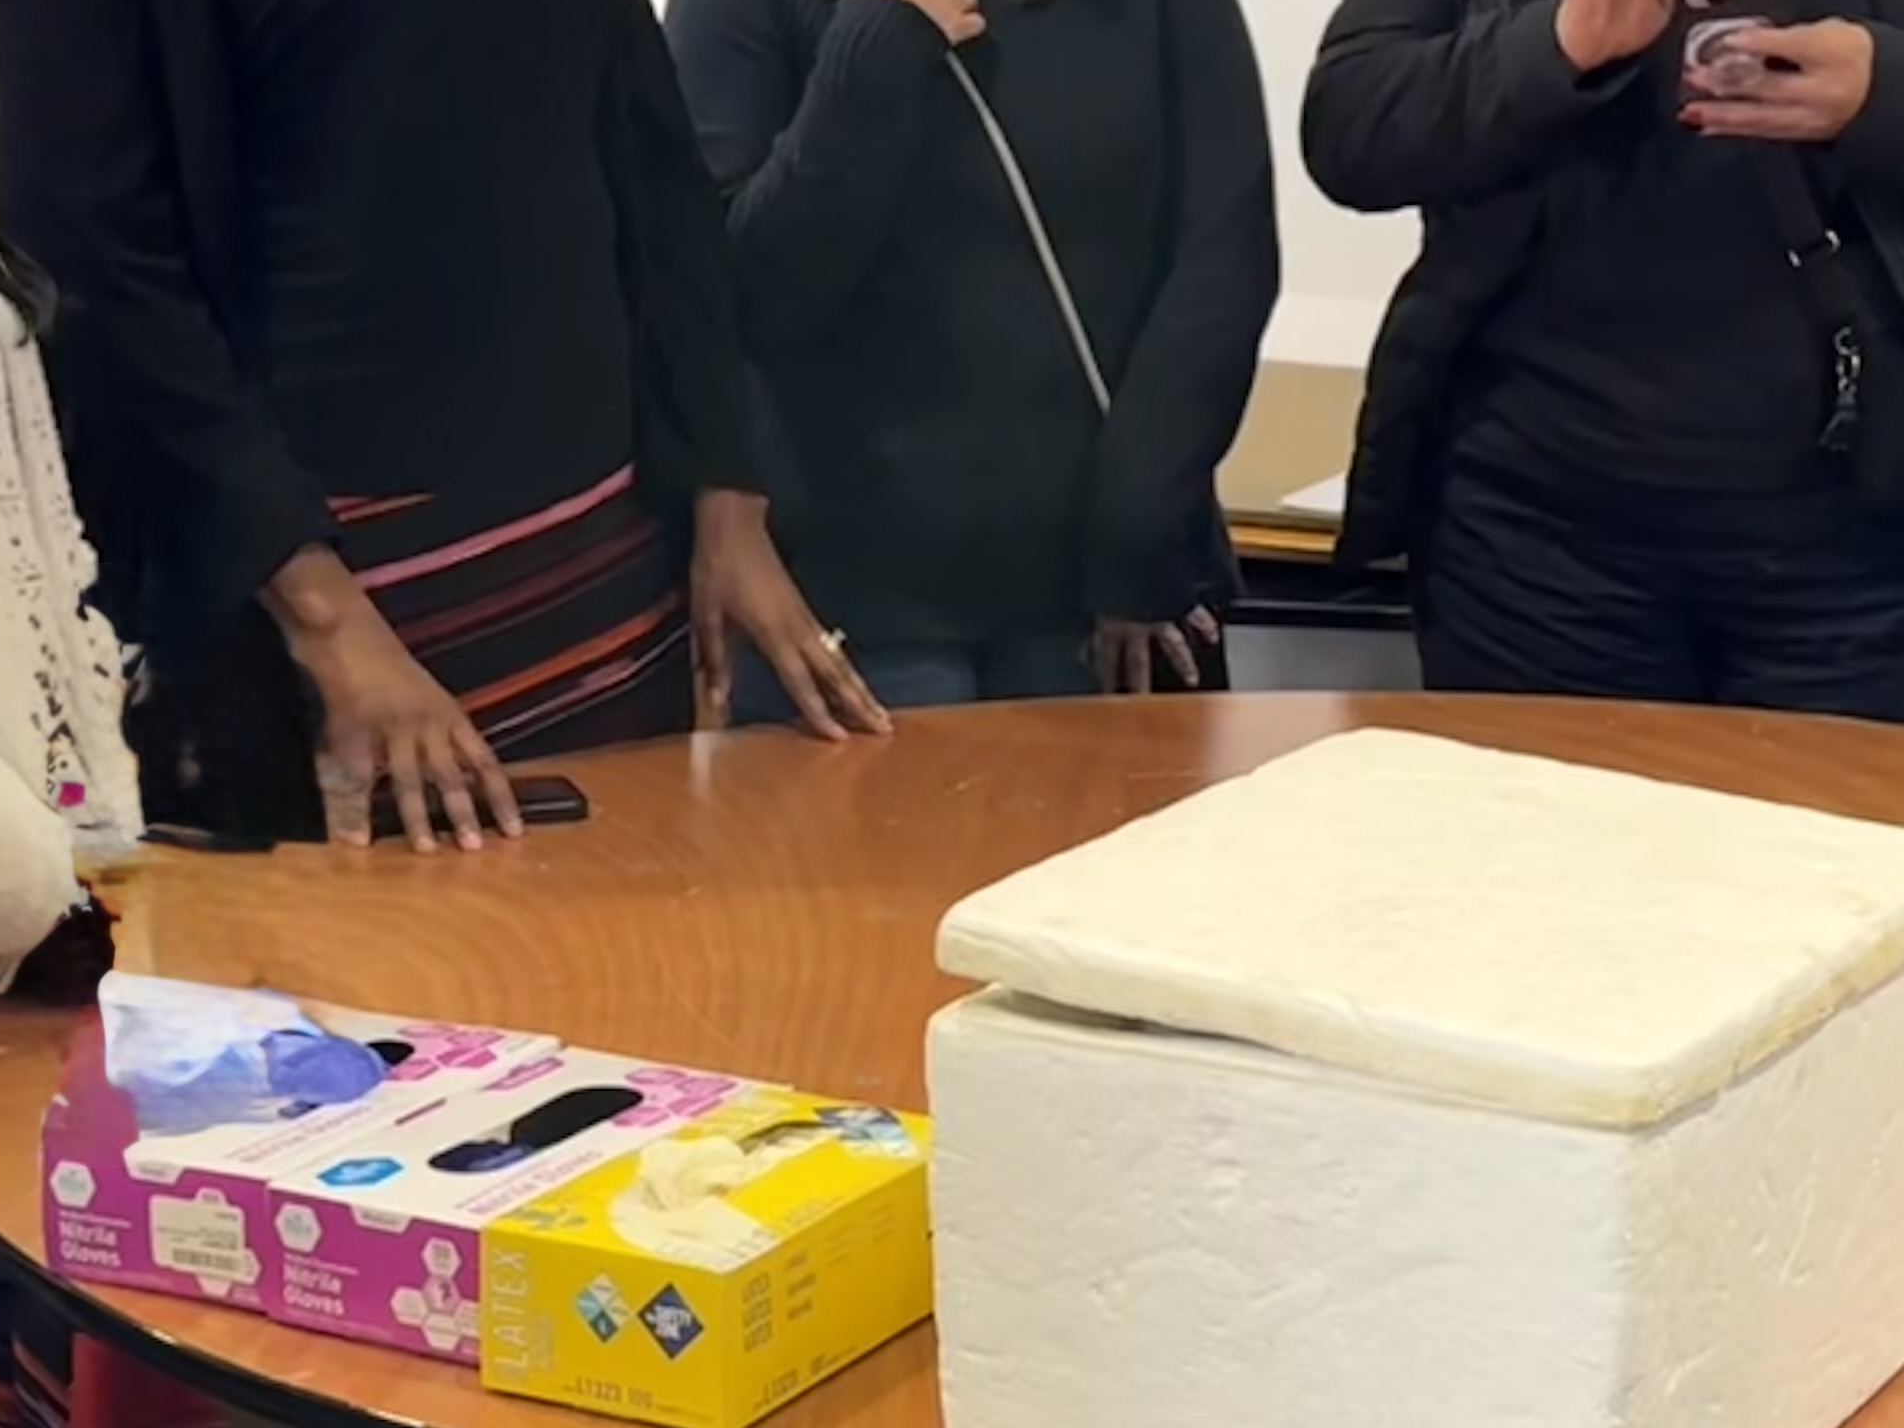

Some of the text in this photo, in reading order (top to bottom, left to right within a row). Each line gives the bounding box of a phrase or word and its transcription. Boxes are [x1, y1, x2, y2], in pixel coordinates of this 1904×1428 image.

[57, 1220, 117, 1246] Nitrile
[59, 1242, 121, 1268] Gloves
[282, 1263, 342, 1294] Nitrile
[282, 1284, 345, 1316] Gloves
[492, 1246, 529, 1369] LATEX
